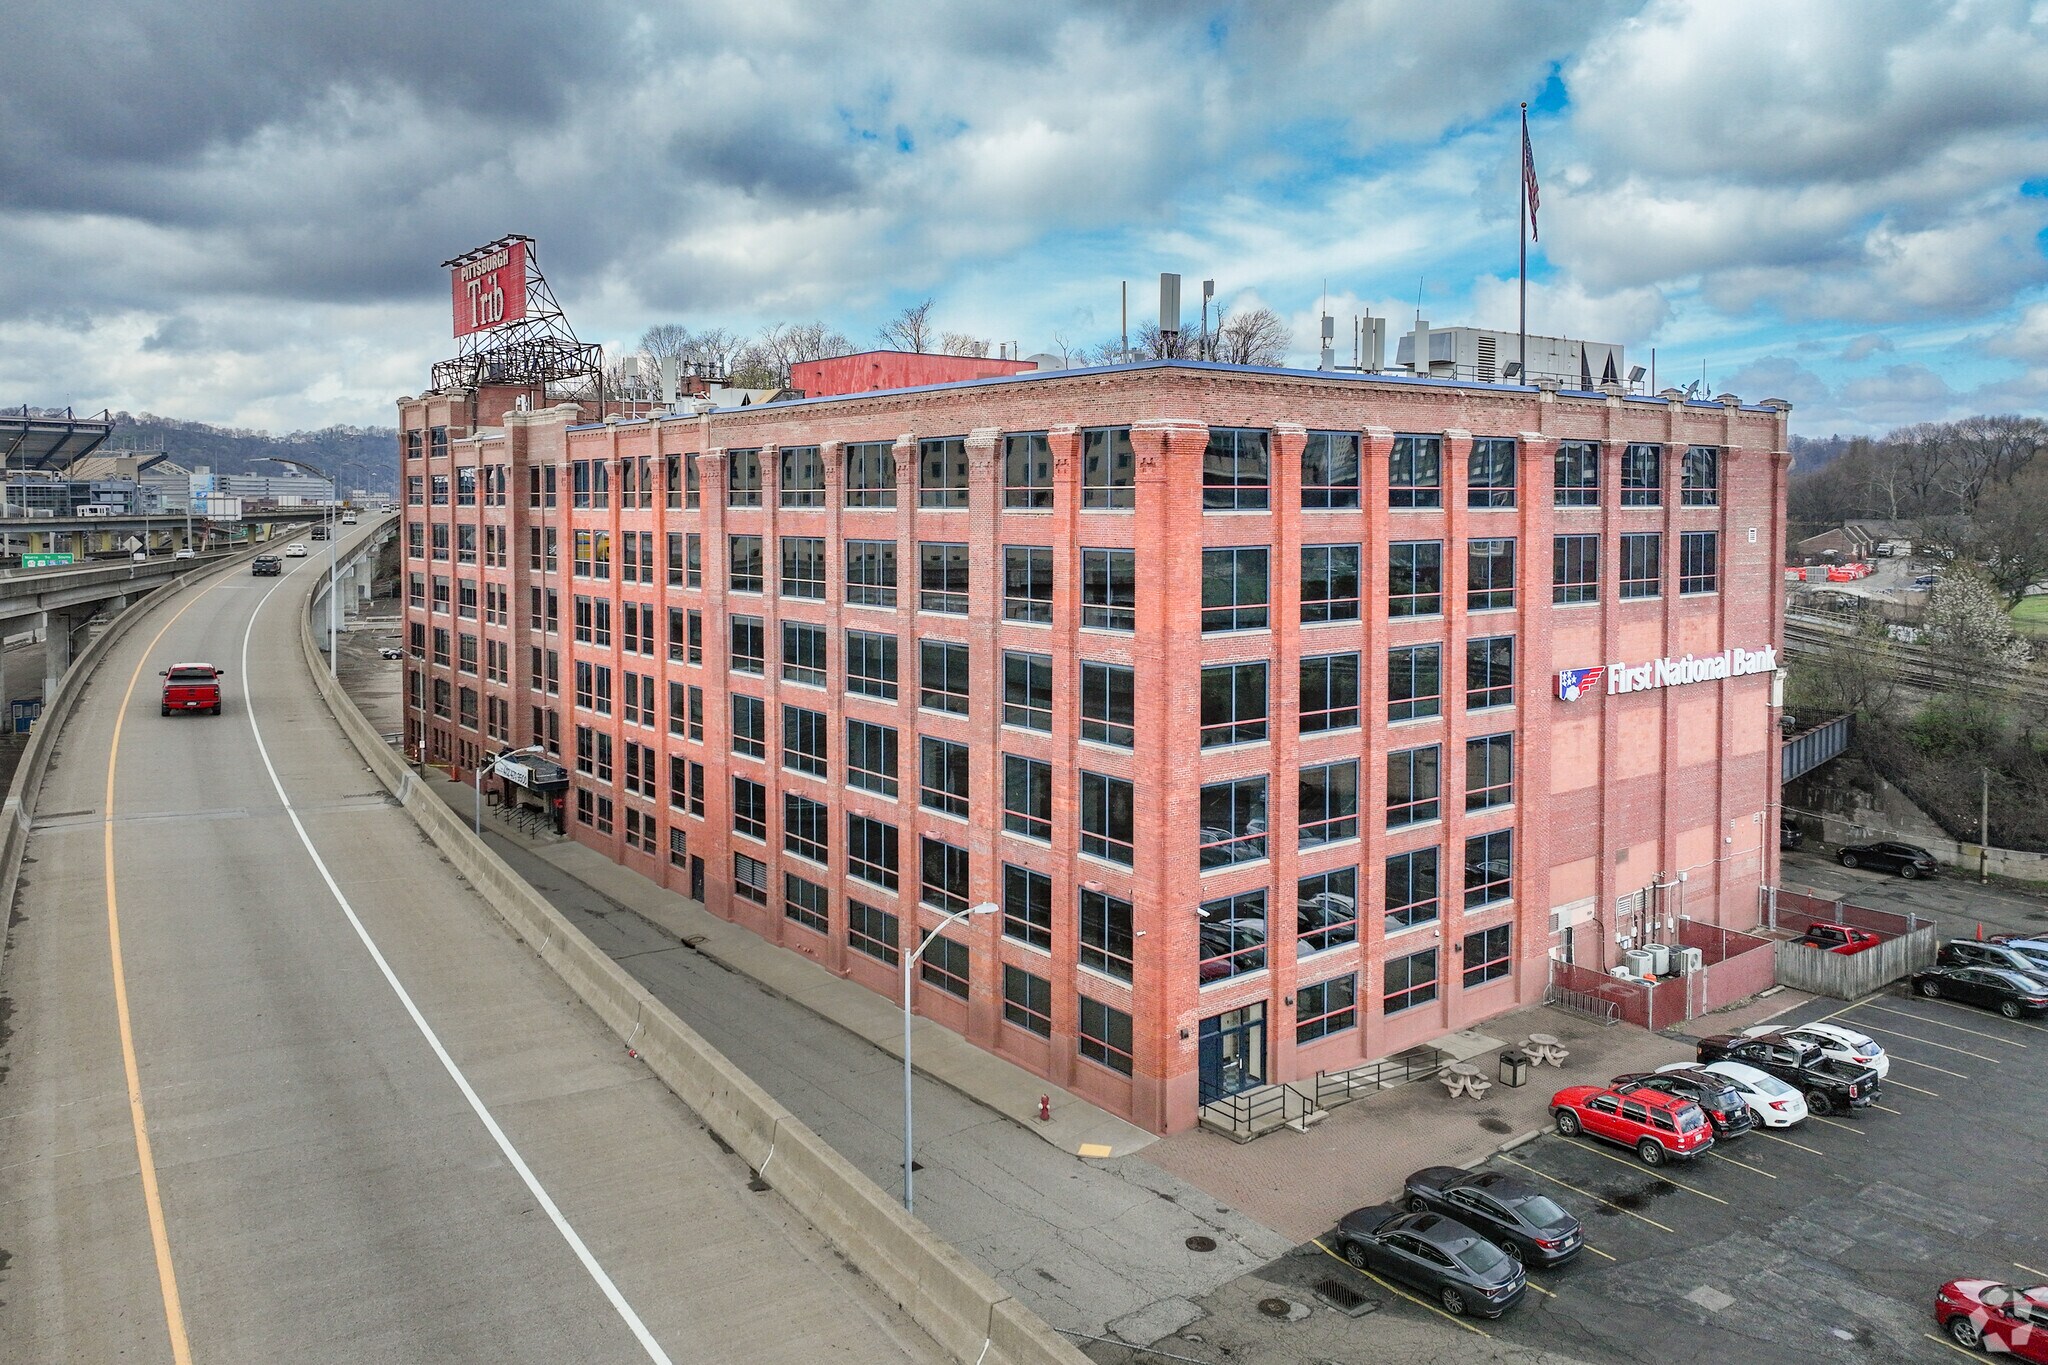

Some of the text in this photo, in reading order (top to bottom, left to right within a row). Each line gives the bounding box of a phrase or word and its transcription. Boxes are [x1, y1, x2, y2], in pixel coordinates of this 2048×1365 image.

[461, 249, 509, 282] PITTSBURGH
[467, 272, 504, 327] Trib
[1607, 645, 1778, 695] First National Bank
